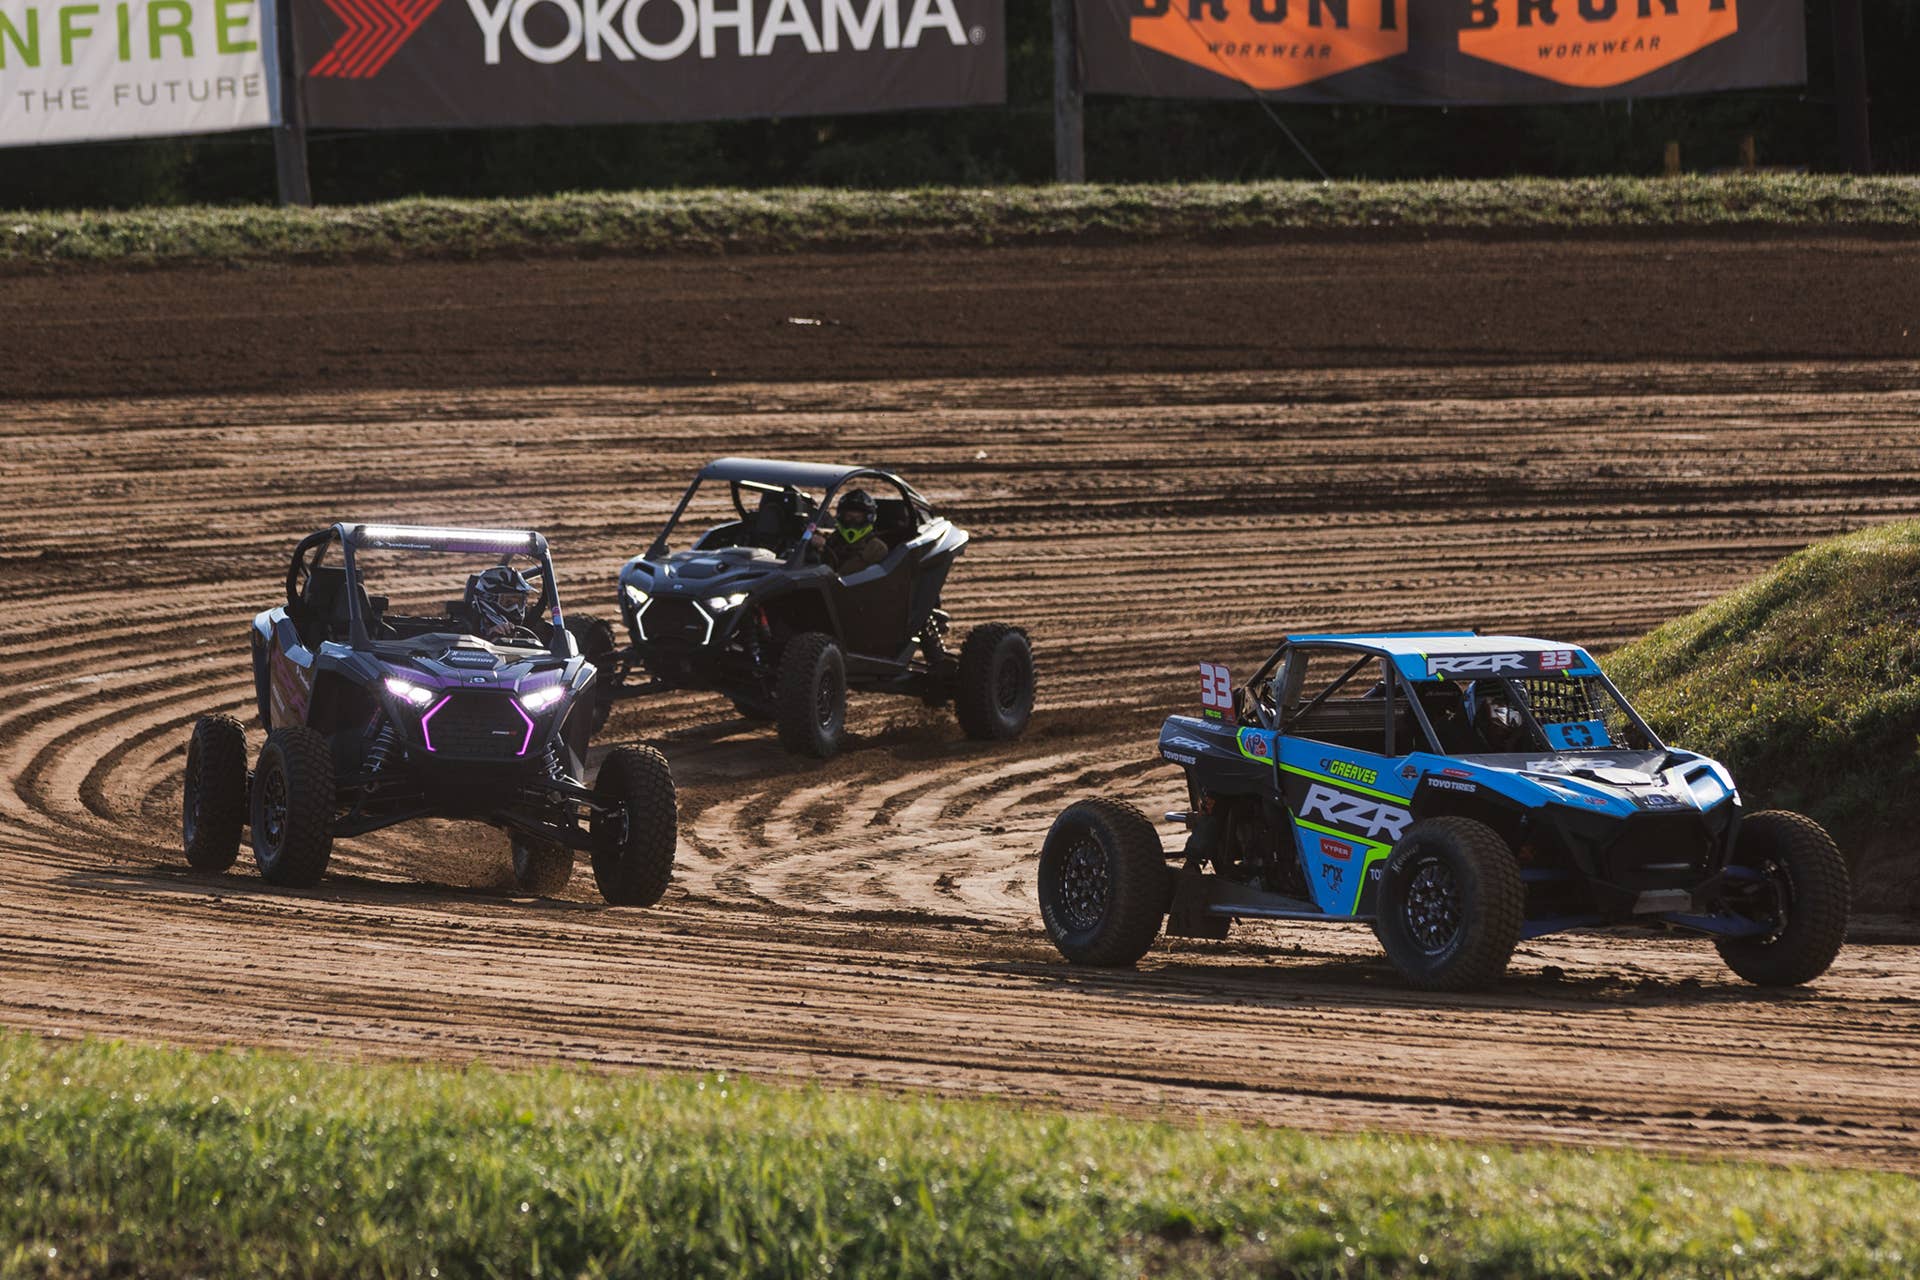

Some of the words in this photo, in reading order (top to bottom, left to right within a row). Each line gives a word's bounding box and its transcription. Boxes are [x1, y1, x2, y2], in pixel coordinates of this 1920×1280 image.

[1459, 0, 1726, 29] BRU
[466, 0, 968, 64] YOKOHAMA
[1207, 43, 1332, 59] WORKWEAR
[1538, 36, 1661, 59] WORKWEAR
[19, 87, 89, 113] THE
[113, 74, 260, 107] FUTURE
[1428, 653, 1528, 675] RZR
[1541, 651, 1571, 667] 33
[1200, 663, 1233, 708] 33
[1330, 760, 1378, 785] GREAVES
[1300, 783, 1414, 841] RZR
[1369, 868, 1382, 881] TO
